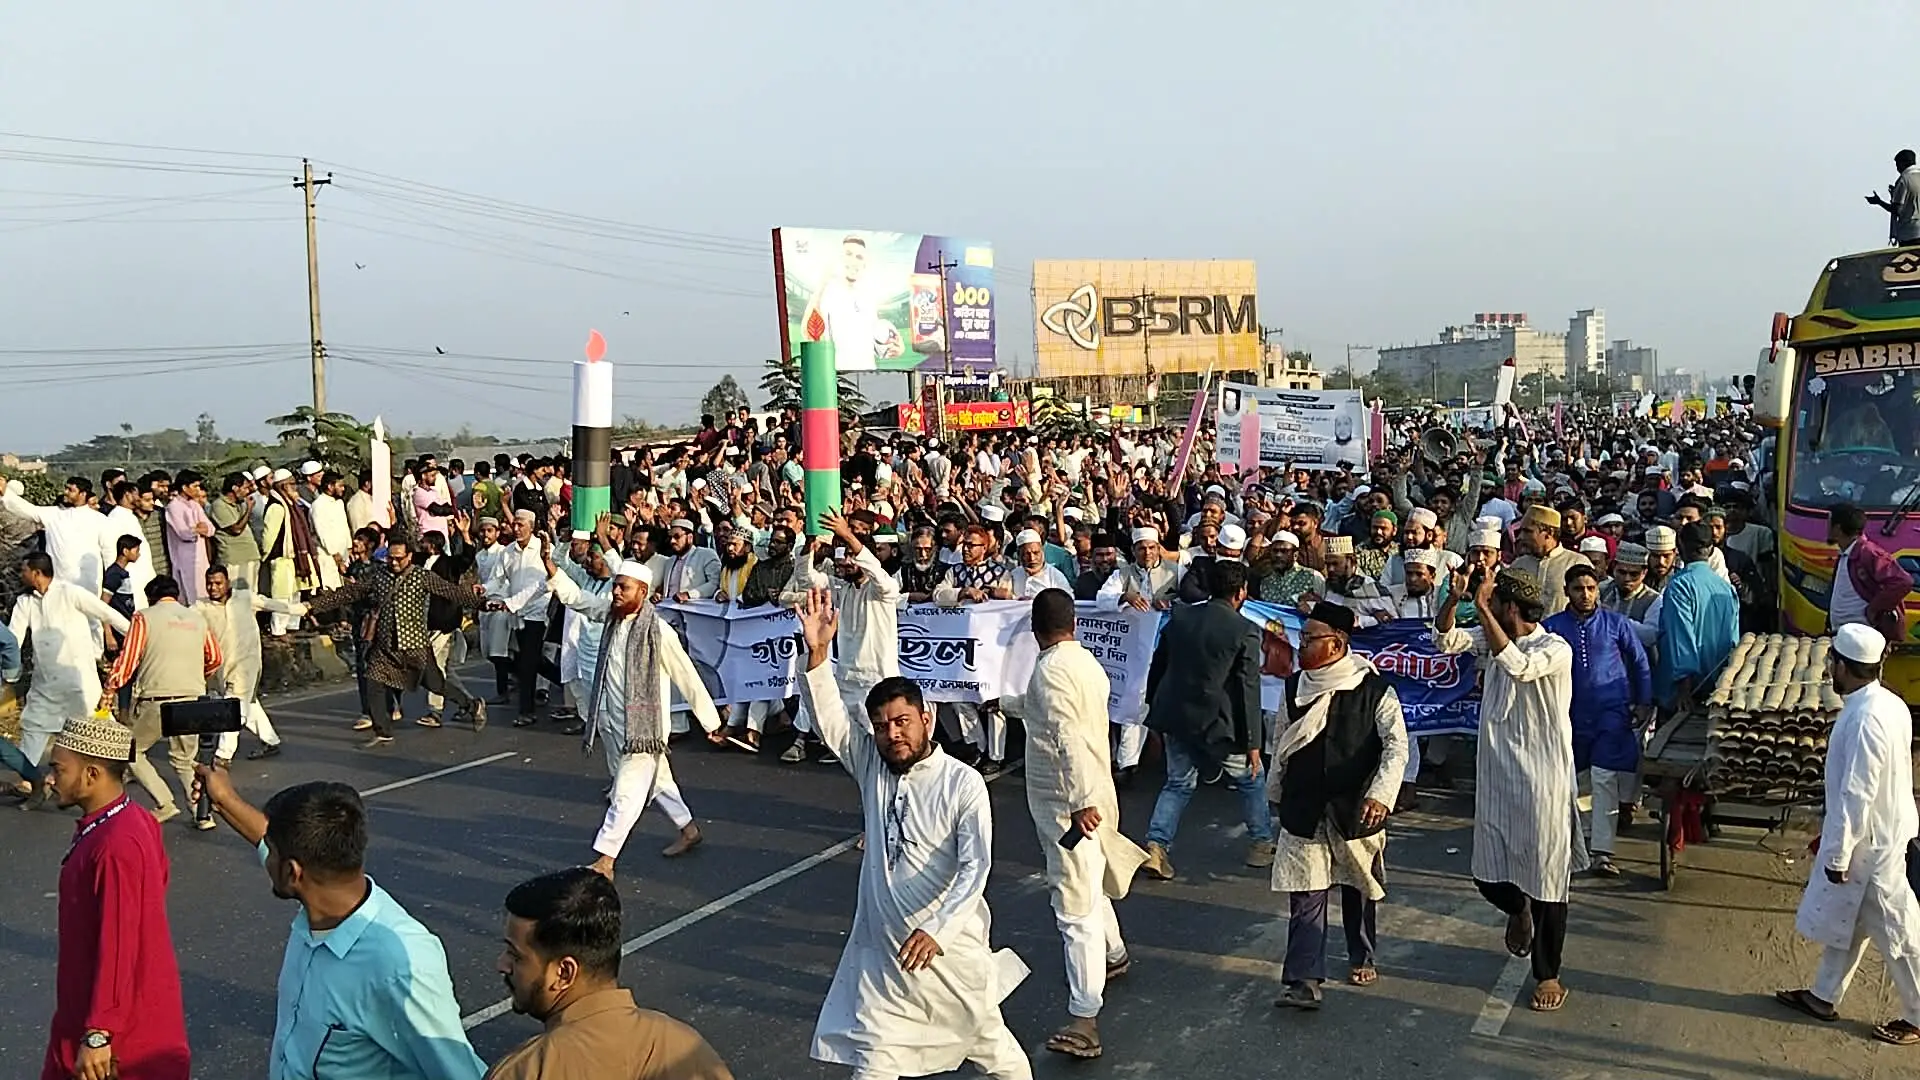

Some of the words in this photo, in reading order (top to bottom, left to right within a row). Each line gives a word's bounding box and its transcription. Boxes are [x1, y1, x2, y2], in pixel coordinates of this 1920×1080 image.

[952, 282, 990, 305] ১০০
[1103, 294, 1257, 337] BSRM
[1076, 617, 1130, 633] মোমবাতি
[1083, 631, 1122, 647] মার্কায়
[1084, 645, 1104, 657] োট
[1107, 647, 1128, 663] দিন
